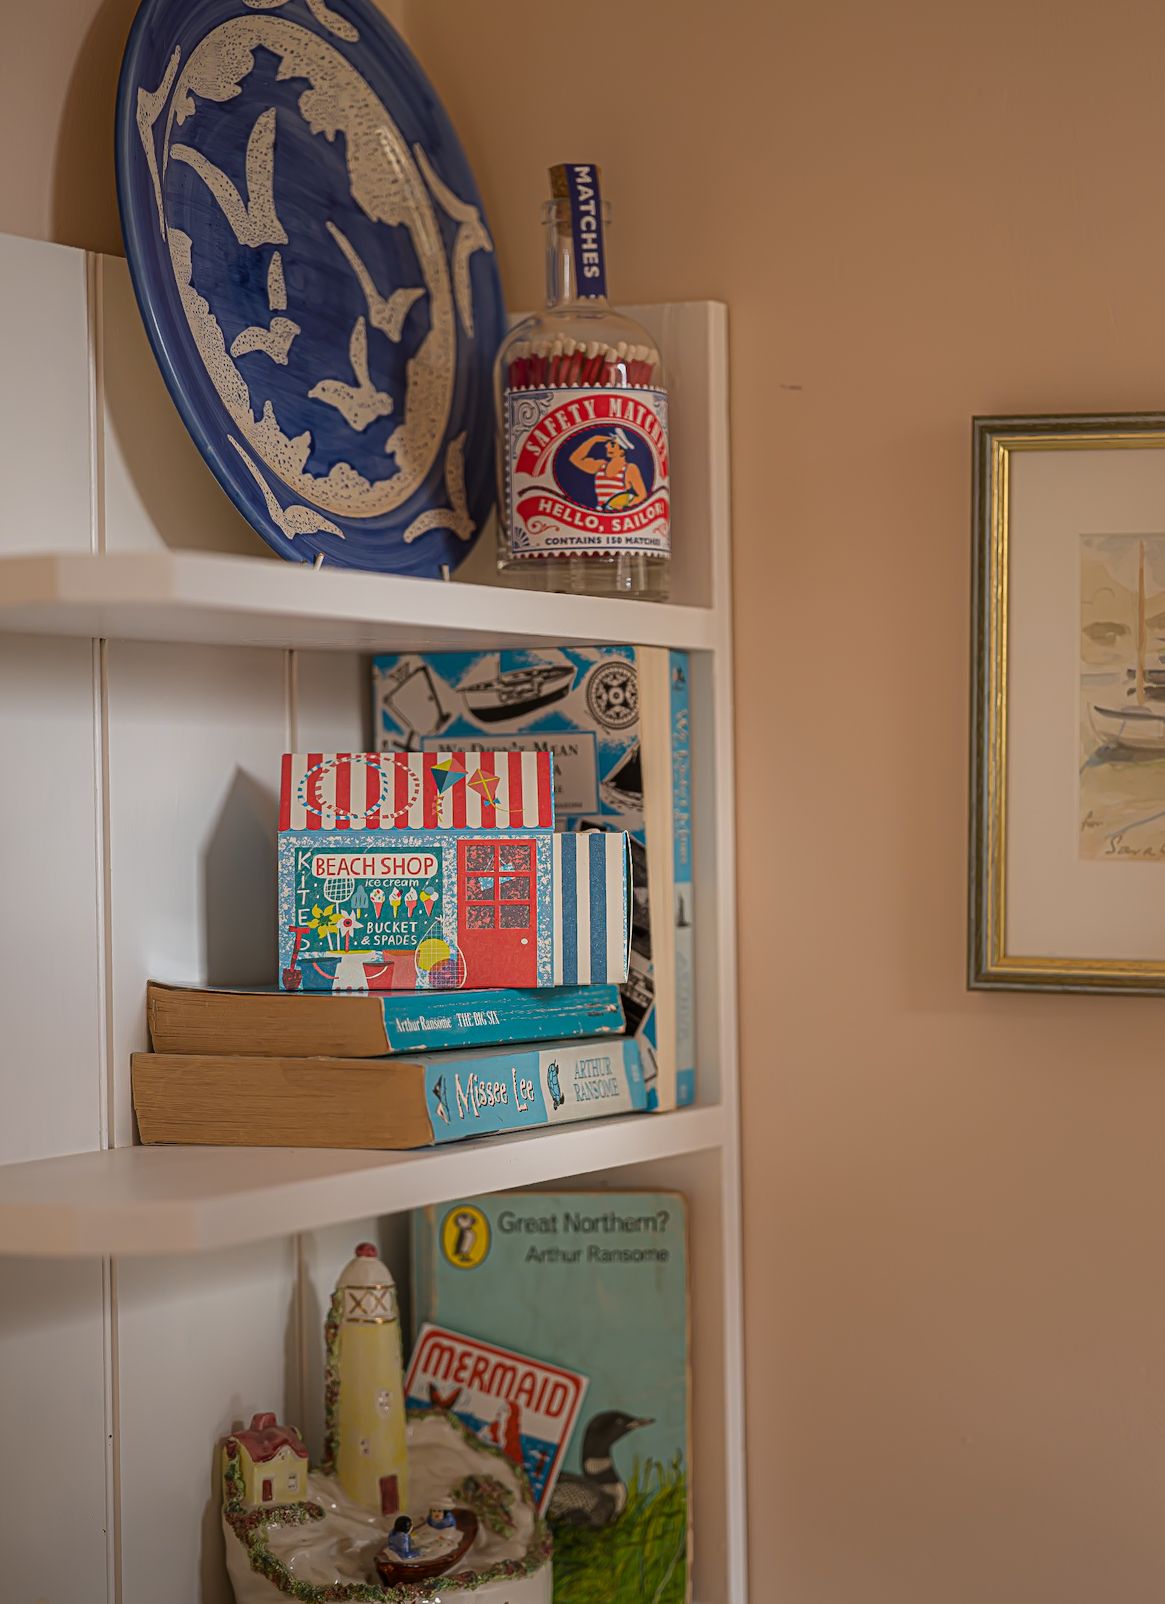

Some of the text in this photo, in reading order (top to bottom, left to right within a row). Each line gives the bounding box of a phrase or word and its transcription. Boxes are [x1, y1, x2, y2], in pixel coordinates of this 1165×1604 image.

[574, 166, 599, 278] MATCHES
[526, 399, 597, 456] SAFETY
[545, 536, 602, 546] CONTAINS
[316, 857, 434, 876] BEACH SHOP
[365, 878, 419, 888] ice cream
[367, 922, 418, 934] BUCKET
[361, 936, 418, 946] & SPADES
[396, 1016, 452, 1032] Arthur Ransome
[456, 1010, 500, 1028] THE BIG SIX
[574, 1056, 613, 1080] ARTHUR
[455, 1067, 534, 1119] Missee Lee
[573, 1077, 620, 1102] RANSOME
[497, 1209, 670, 1235] Great Northern?
[526, 1244, 670, 1263] Arthur Ransome
[422, 1342, 570, 1420] MERMAID
